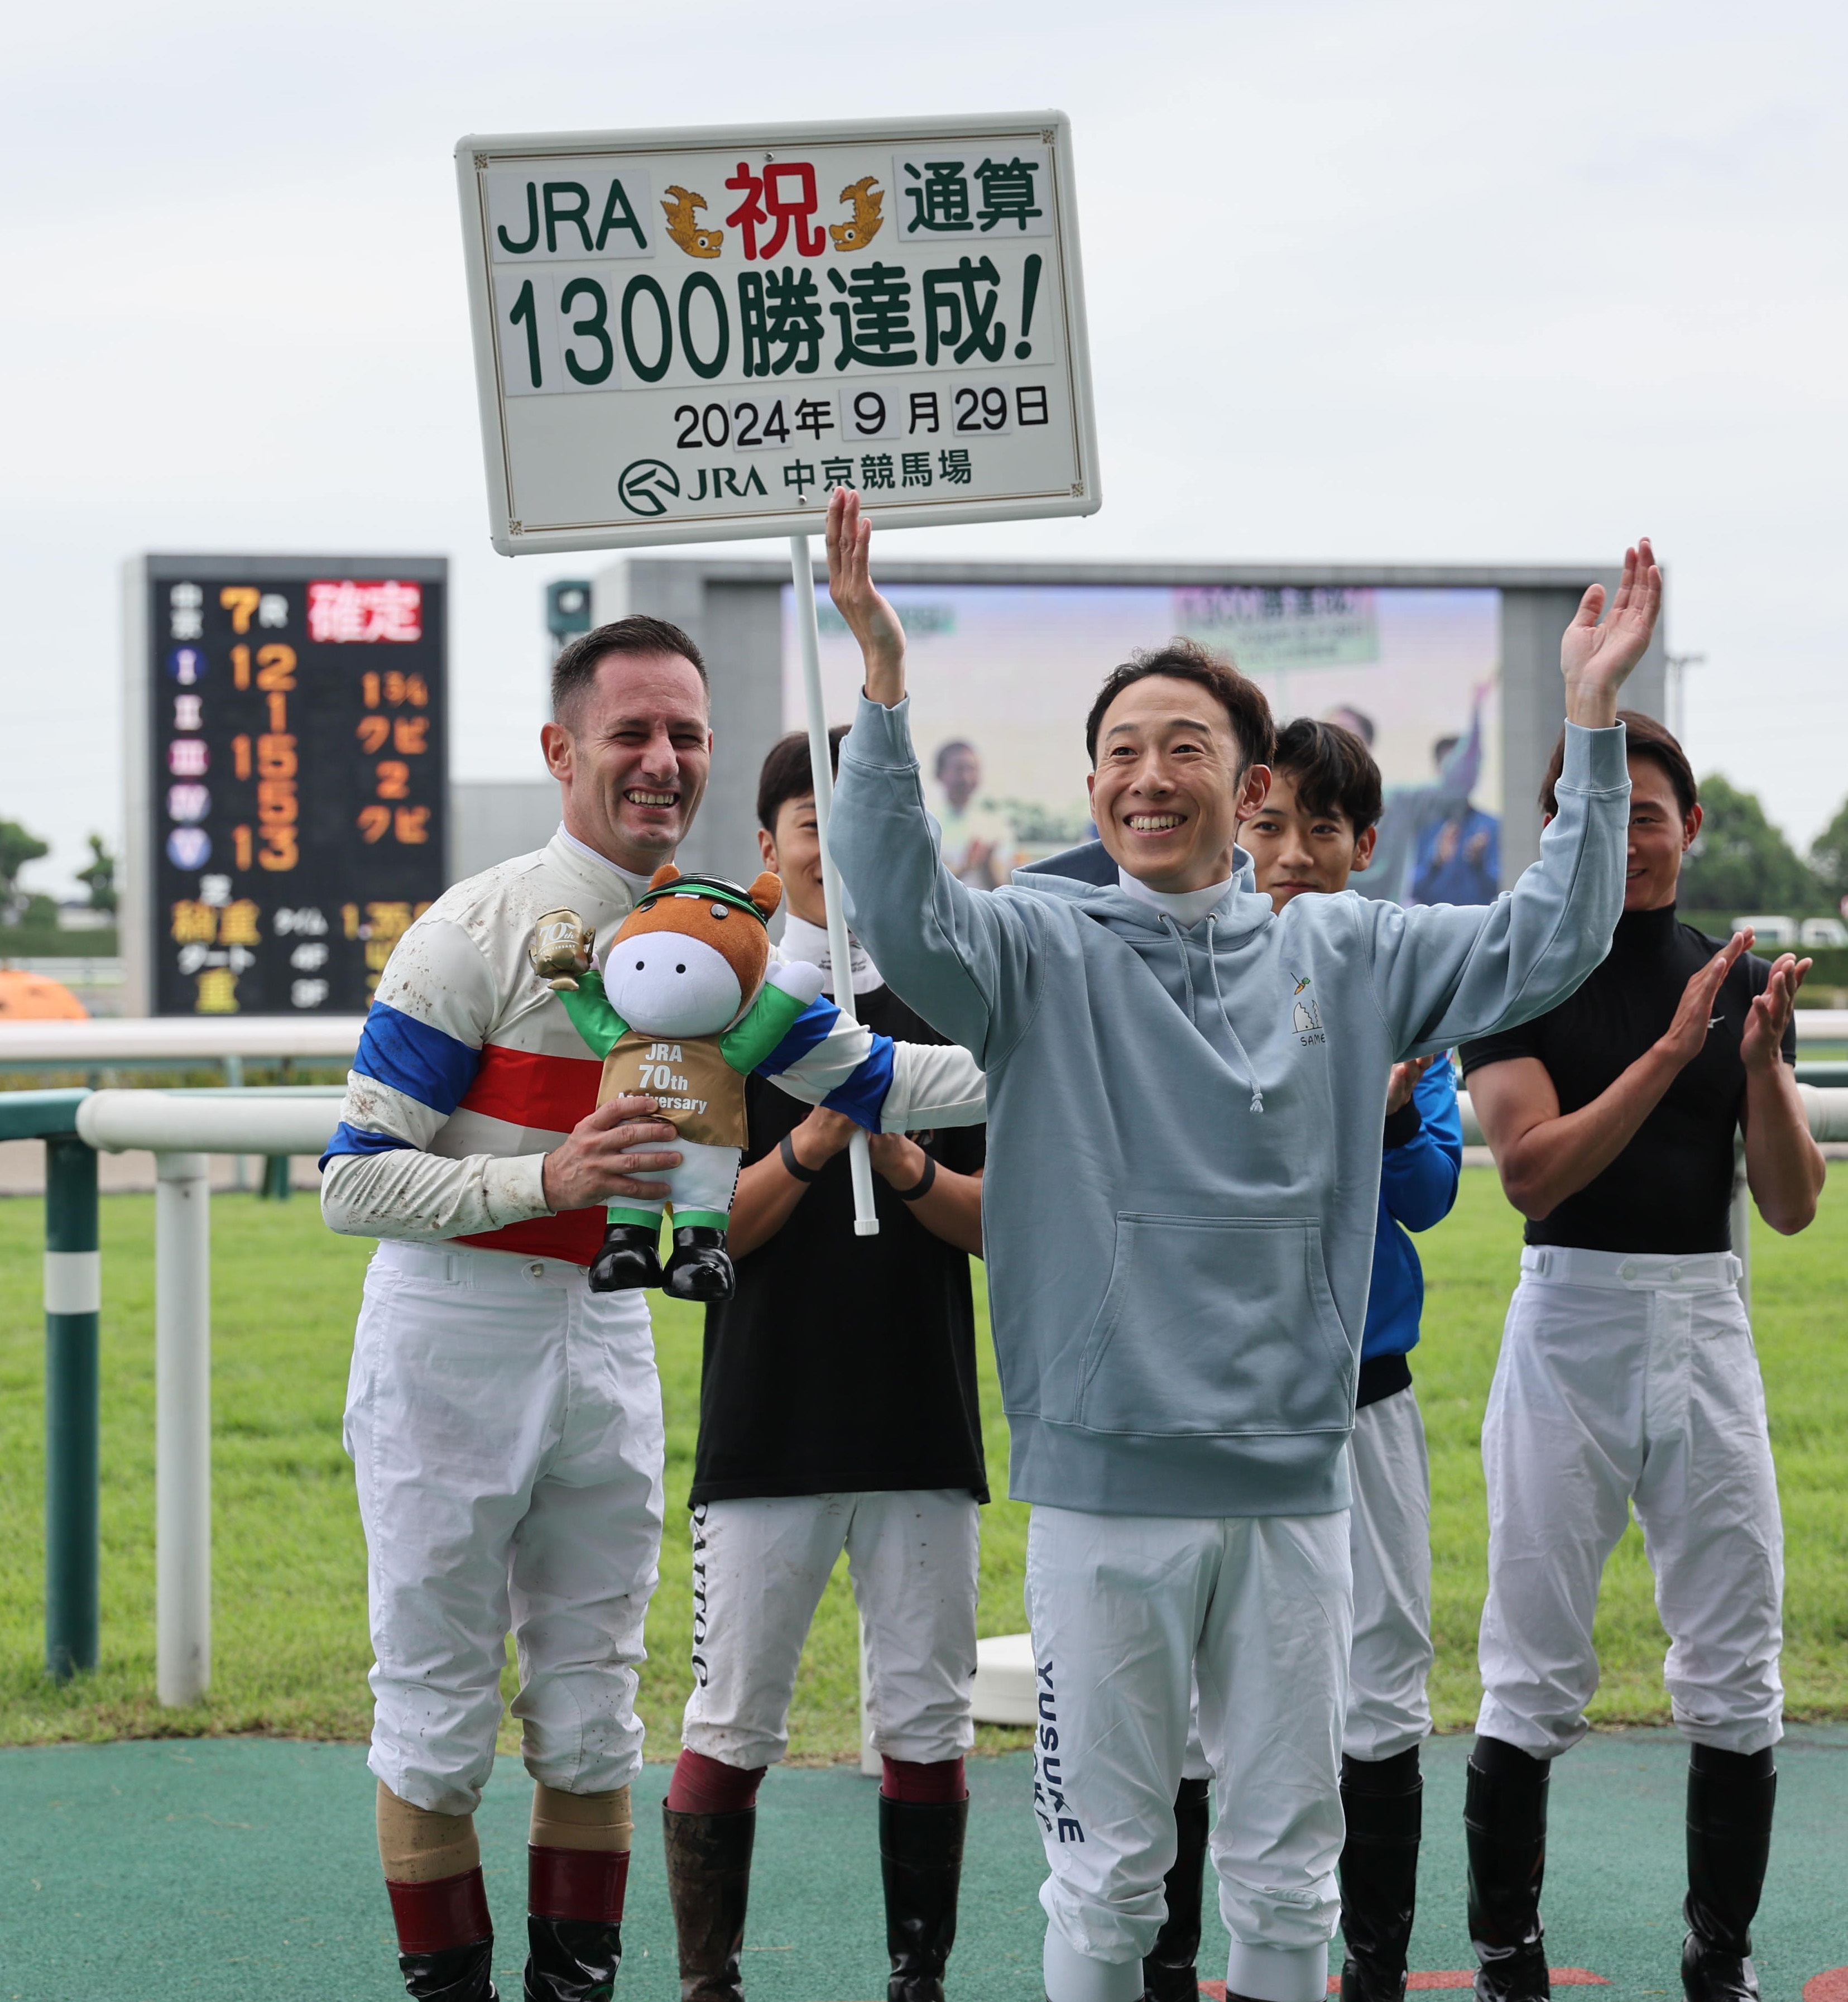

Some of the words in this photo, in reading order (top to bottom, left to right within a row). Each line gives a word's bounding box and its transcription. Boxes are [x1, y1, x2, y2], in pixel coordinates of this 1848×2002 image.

[497, 178, 648, 254] JRA
[725, 162, 825, 261] 祝
[904, 156, 1043, 233] 通算
[509, 253, 1043, 389] 1300勝達成!
[688, 464, 769, 501] JRA
[783, 449, 972, 496] 中京競馬場
[231, 643, 297, 692] 12
[266, 691, 287, 732] 1
[357, 715, 430, 755] クビ
[231, 732, 298, 780] 15
[376, 760, 410, 799] 2
[257, 779, 298, 825] 5
[358, 805, 430, 844] クビ
[232, 823, 299, 871] 13
[539, 921, 578, 947] 70th
[645, 1043, 683, 1062] JRA
[1300, 1033, 1326, 1047] SAME
[639, 1064, 688, 1091] 70th
[618, 1092, 708, 1115] ersary
[1038, 1660, 1086, 1843] YUSUKE
